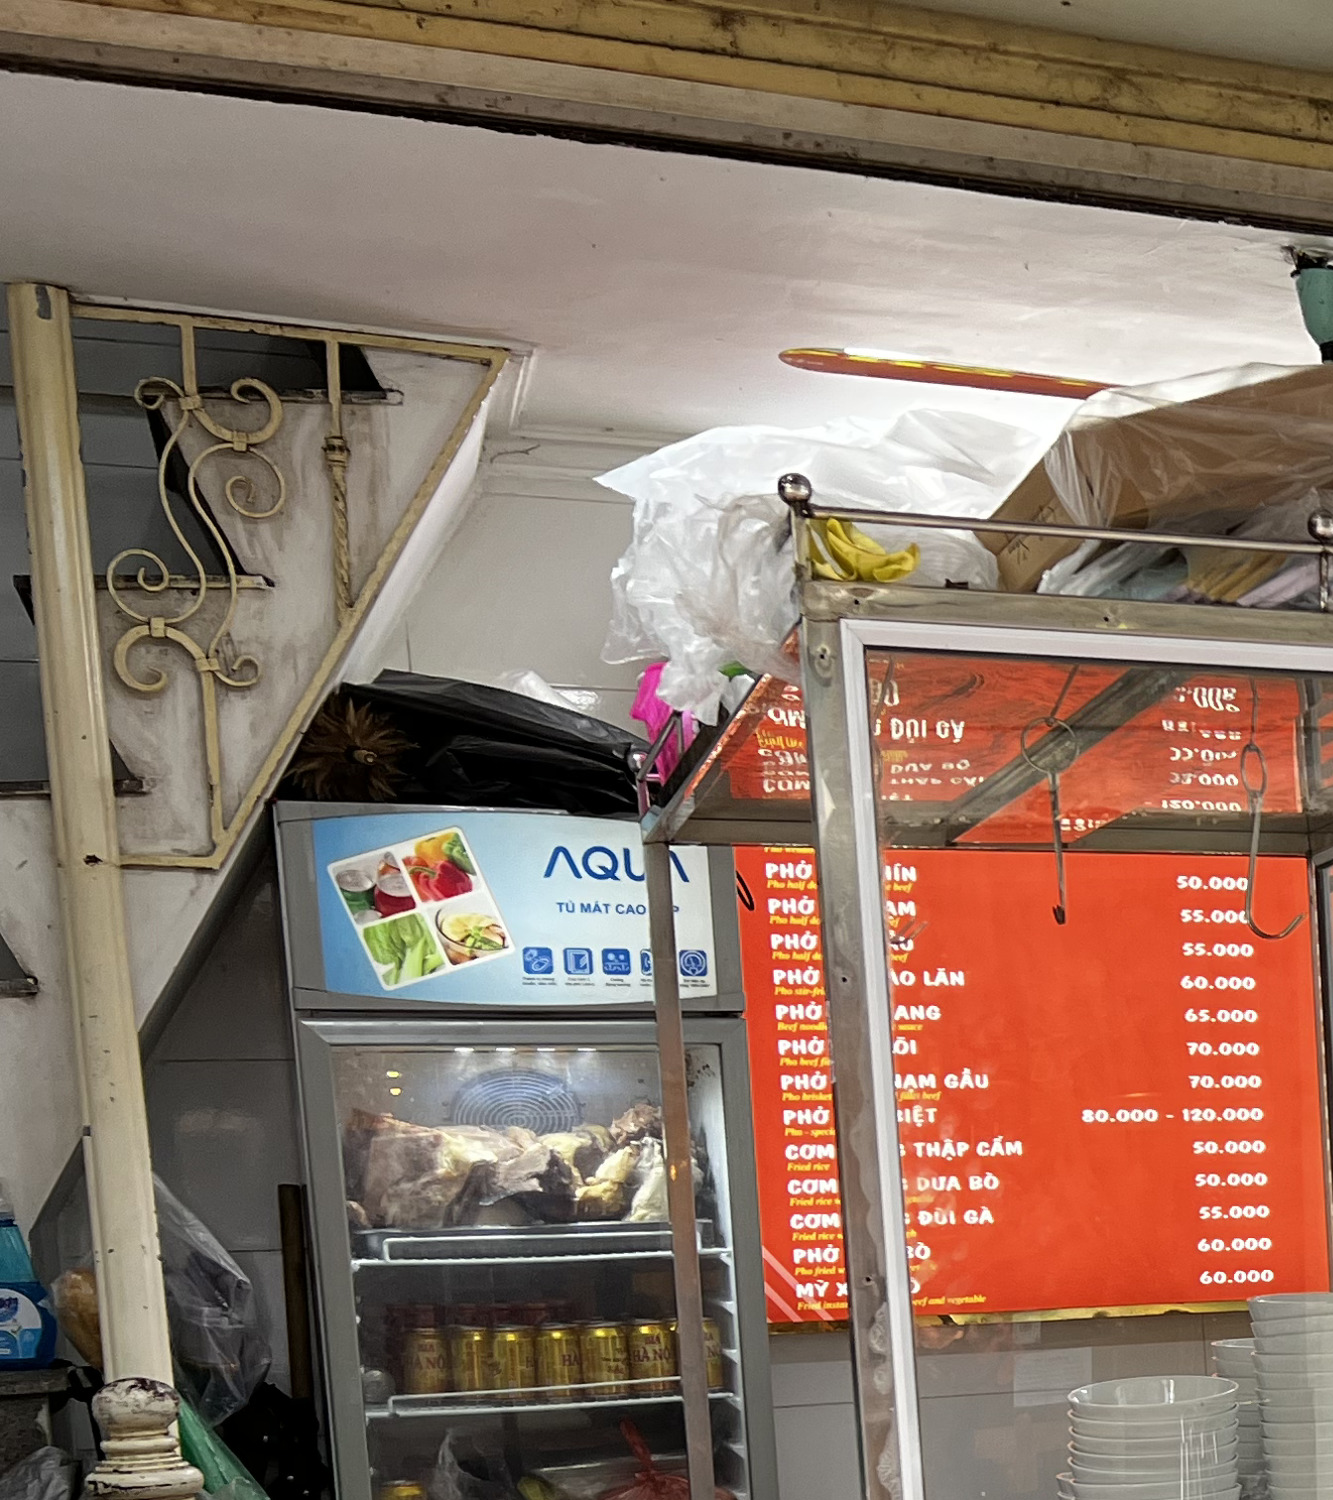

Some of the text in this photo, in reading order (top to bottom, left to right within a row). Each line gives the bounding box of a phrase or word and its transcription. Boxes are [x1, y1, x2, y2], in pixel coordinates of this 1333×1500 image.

[765, 859, 1249, 892] PHỞ 50.000
[556, 899, 646, 914] TỦ MÁT CAO
[767, 895, 815, 915] PHỞ
[770, 930, 1254, 957] PHỞ 55.000
[773, 965, 820, 986] PHỞ
[923, 967, 965, 987] LĂN
[1180, 975, 1256, 991] 60.000
[775, 1000, 1258, 1023] PHỞ 65.000
[777, 1035, 1260, 1056] PHỞ 70.000
[780, 1067, 1262, 1091] PHỞ GẦU 70.000
[783, 1105, 830, 1126] PHỞ
[1081, 1108, 1159, 1123] 80.000
[1182, 1107, 1264, 1122] 120.000
[784, 1143, 836, 1161] CƠM
[912, 1138, 970, 1161] THẬP
[1192, 1140, 1267, 1155] 50.000
[787, 1178, 839, 1195] CƠM
[916, 1175, 962, 1192] DƯA
[968, 1171, 1000, 1191] BÒ
[1195, 1172, 1268, 1187] 50.000
[789, 1212, 841, 1230] CƠM
[963, 1205, 995, 1225] GÀ
[1199, 1205, 1270, 1220] 55.000
[793, 1237, 1273, 1265] PHỞ 60.000
[1199, 1269, 1274, 1285] 60.000
